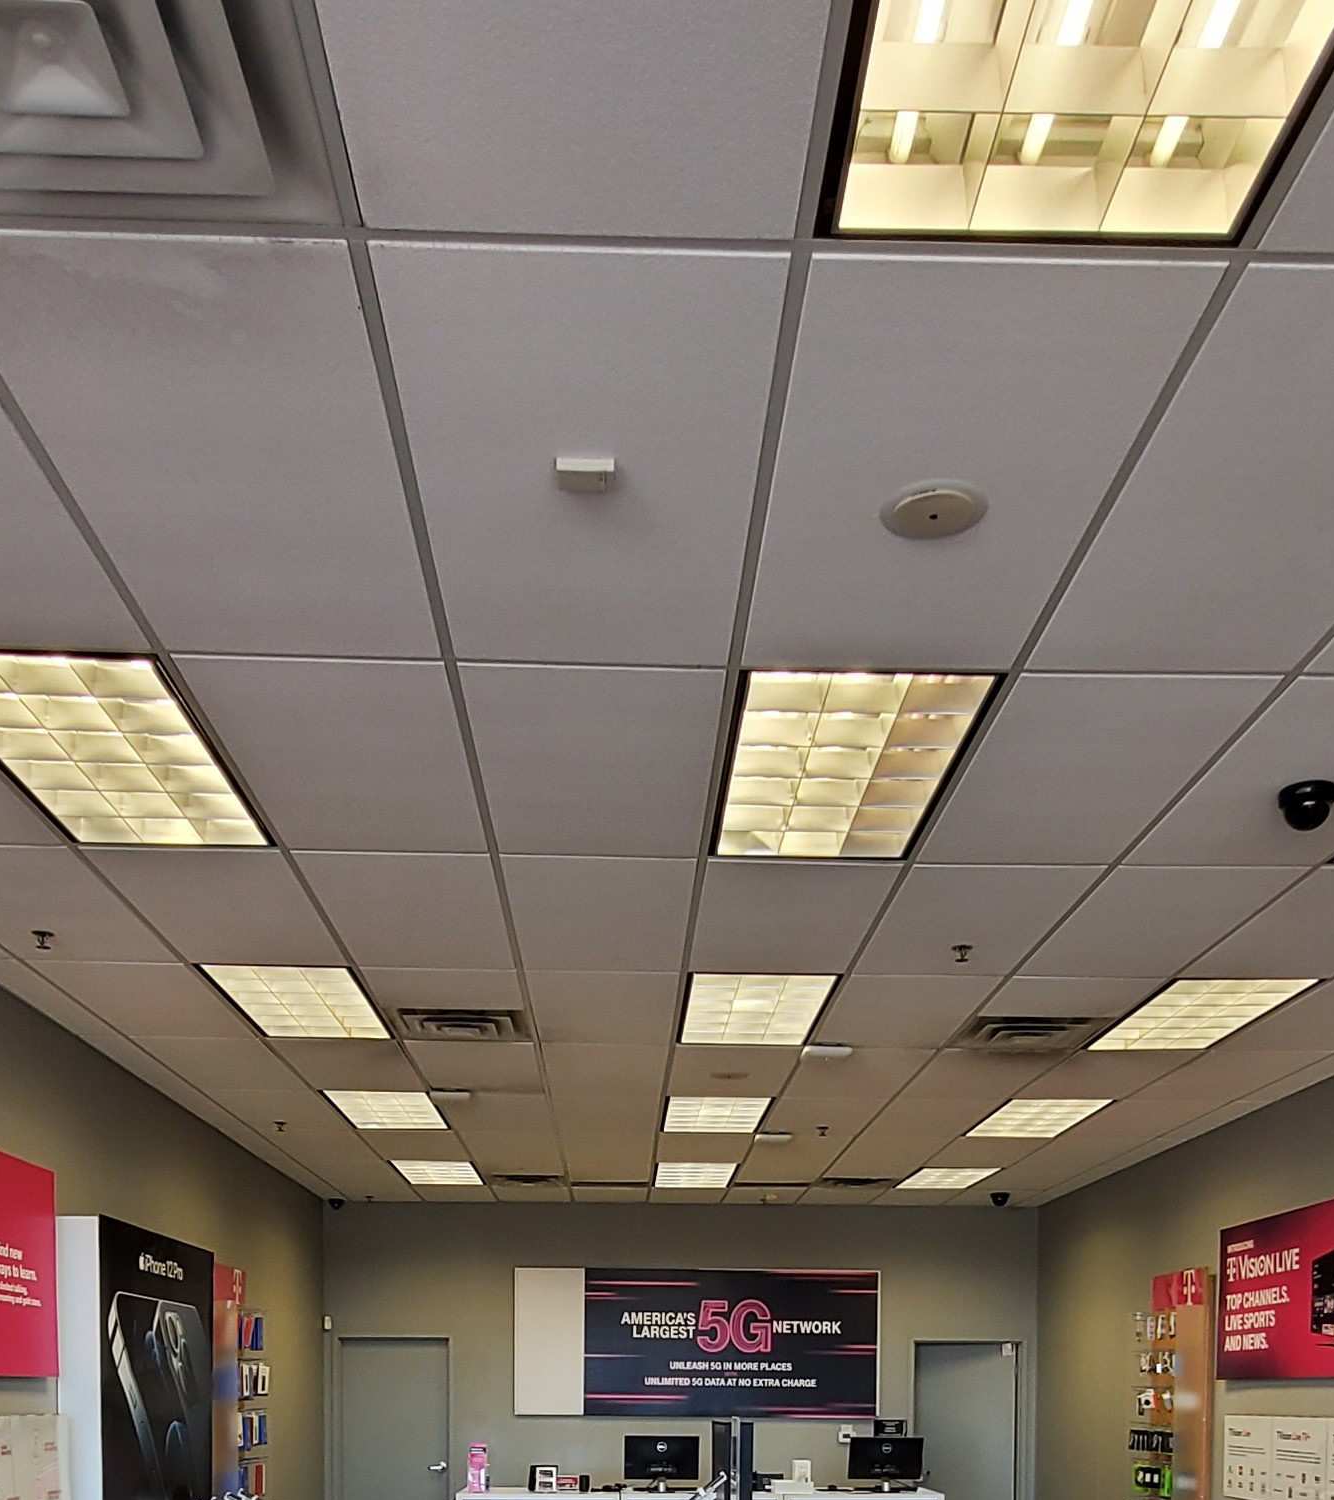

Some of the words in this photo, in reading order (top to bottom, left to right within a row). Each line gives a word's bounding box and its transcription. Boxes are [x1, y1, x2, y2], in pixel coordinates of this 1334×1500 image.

[144, 1254, 167, 1277] iPhone
[1276, 1248, 1300, 1273] LIVE
[1225, 1292, 1243, 1311] TOP
[620, 1311, 697, 1326] AMERICA'S
[696, 1299, 772, 1353] 5G
[772, 1320, 842, 1335] NETWORK
[1224, 1313, 1244, 1331] LIVE
[1244, 1310, 1276, 1330] SPORTS
[632, 1325, 696, 1340] LARGEST
[1223, 1334, 1242, 1352] AND
[669, 1360, 709, 1371] UNLEASH
[710, 1361, 722, 1371] 5G
[723, 1361, 733, 1371] IN
[733, 1361, 759, 1371] MORE
[760, 1361, 793, 1372] PLACES
[644, 1376, 691, 1387] UNLIMITED
[691, 1377, 704, 1387] 5G
[704, 1377, 727, 1387] DATA
[726, 1377, 737, 1387] AT
[738, 1377, 752, 1387] NO
[753, 1378, 781, 1388] EXTRA
[781, 1378, 817, 1388] CHARGE
